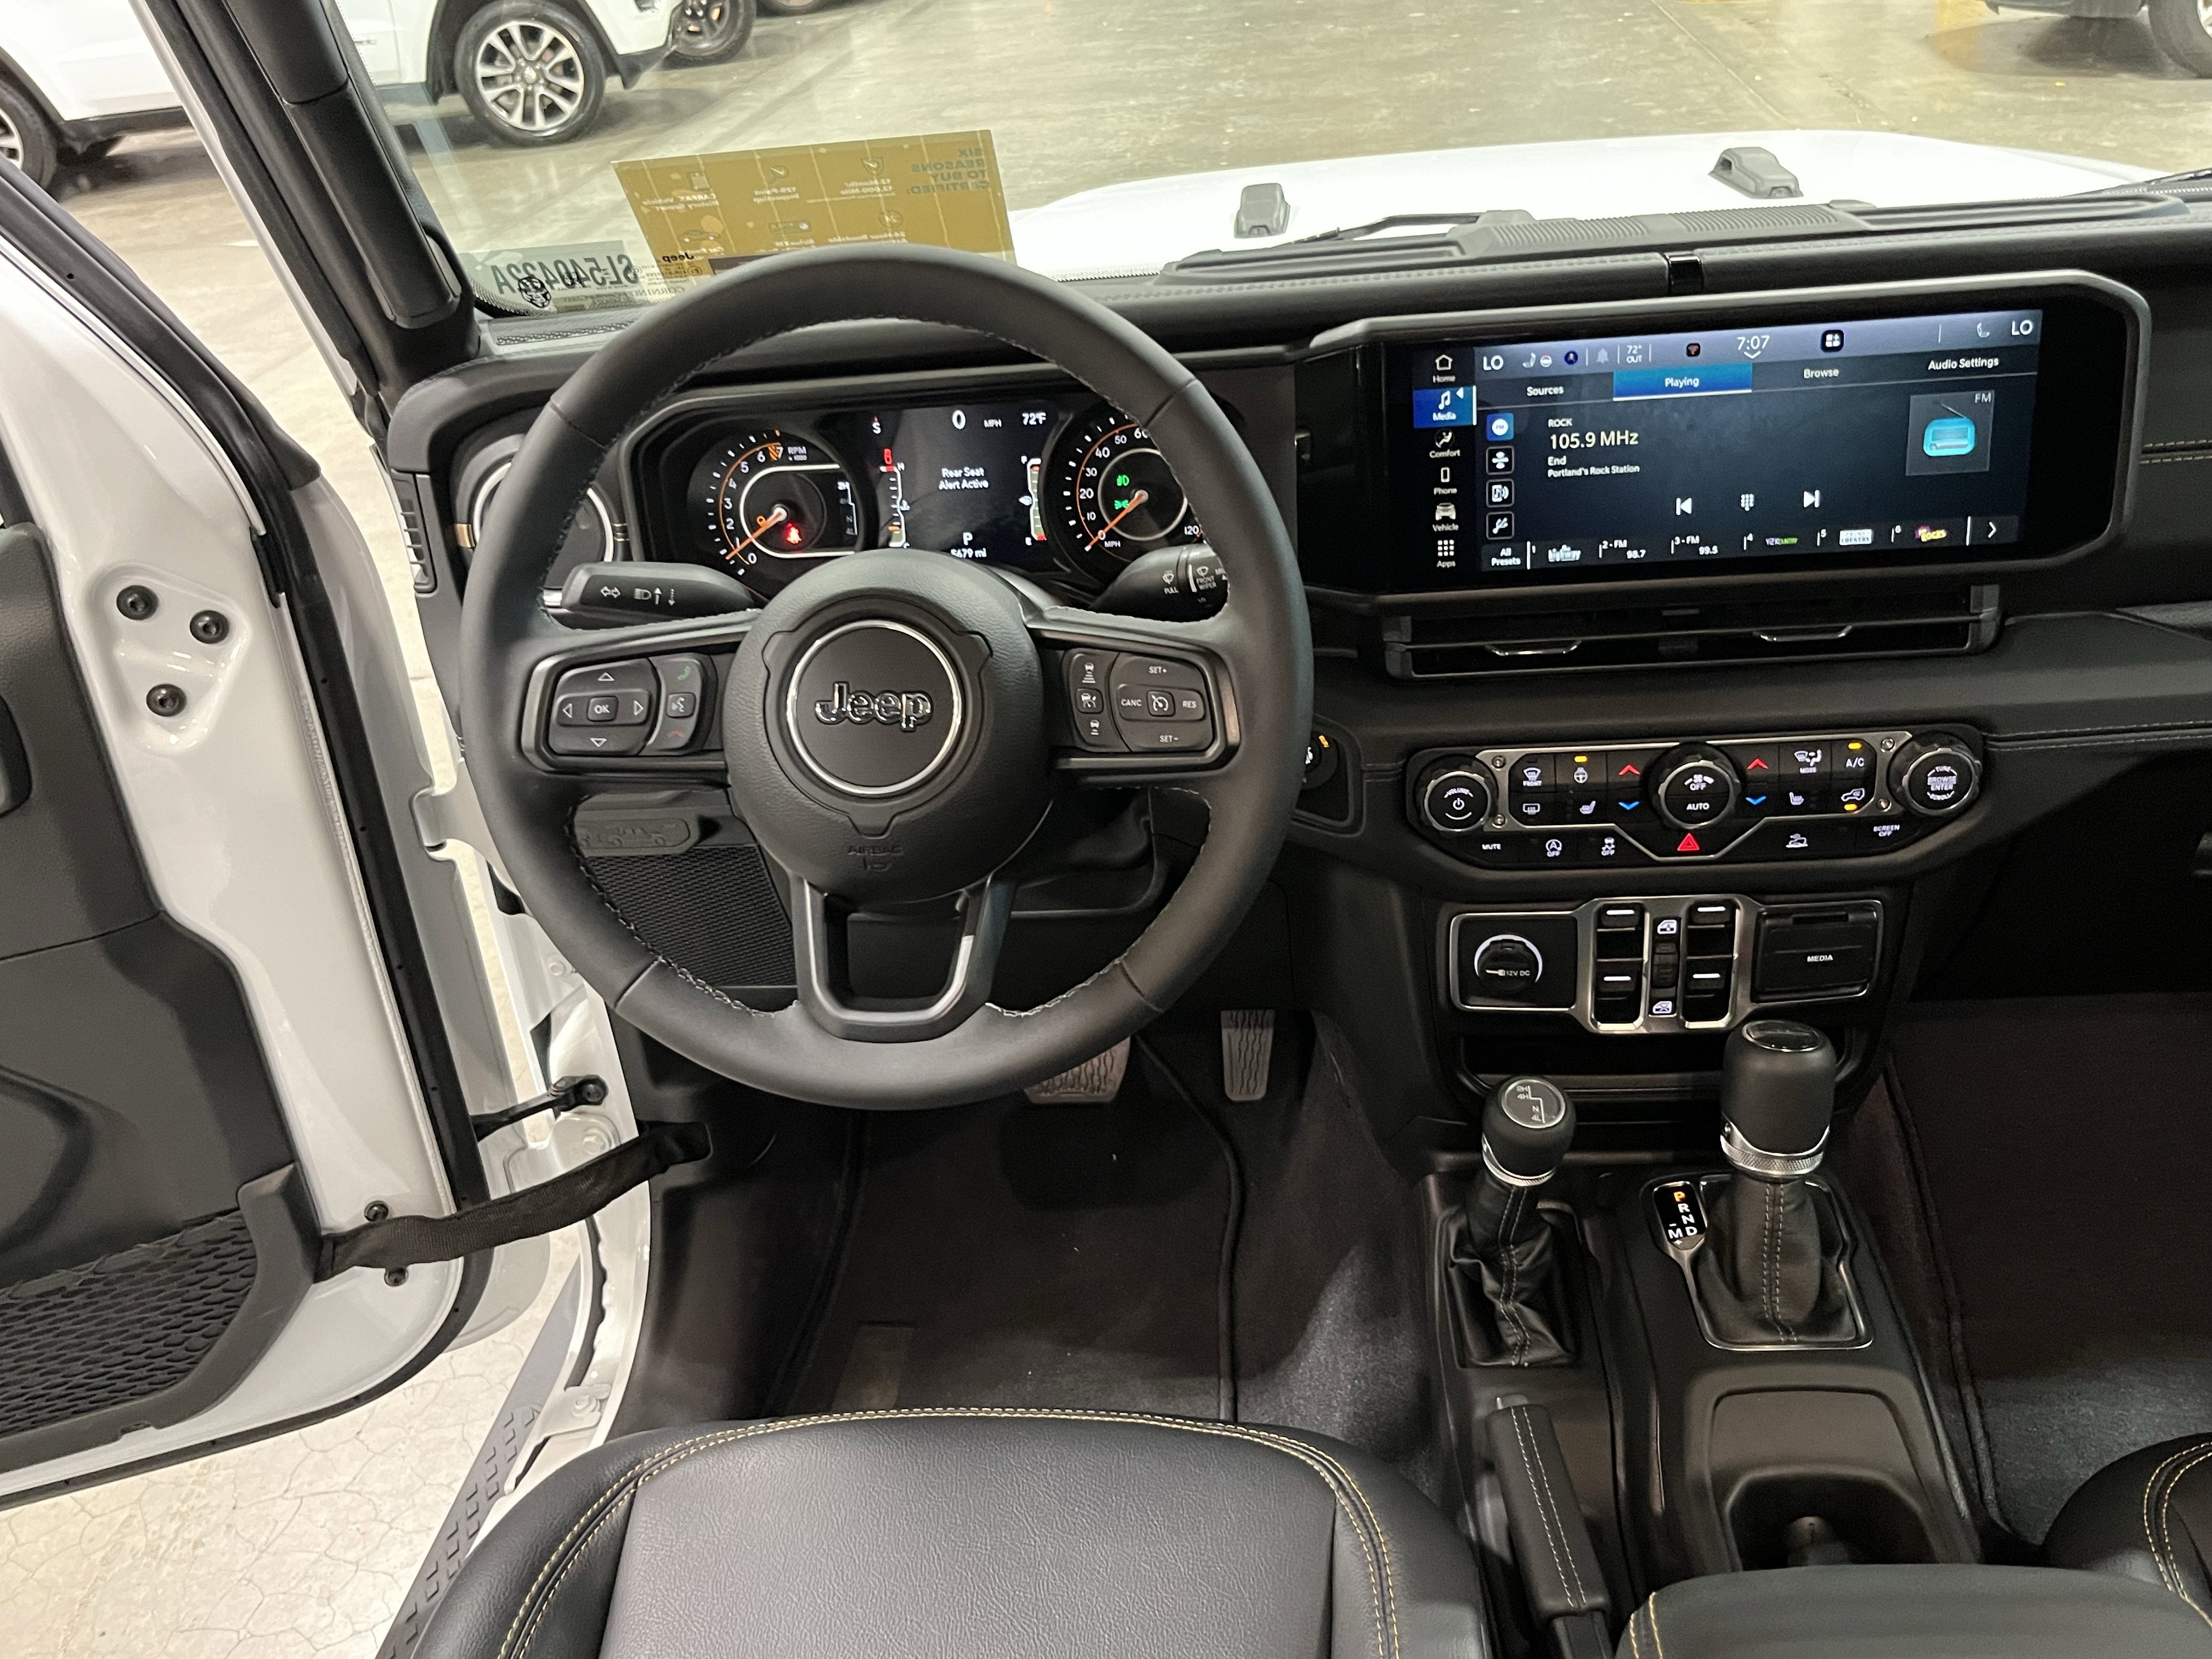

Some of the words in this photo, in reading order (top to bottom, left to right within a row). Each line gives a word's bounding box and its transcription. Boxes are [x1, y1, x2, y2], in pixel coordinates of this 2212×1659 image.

[2011, 319, 2033, 336] LO
[1737, 335, 1770, 350] 7:07
[1482, 354, 1504, 371] LO
[1626, 354, 1643, 364] OUT
[1928, 358, 1957, 371] Audio
[1959, 356, 2000, 370] Settings
[1803, 367, 1839, 379] Browse
[1432, 375, 1456, 383] Home
[1664, 376, 1700, 388] Playing
[1526, 385, 1564, 397] Sources
[1974, 392, 1991, 403] FM
[952, 409, 966, 430] 0
[1432, 411, 1457, 421] Media
[872, 421, 882, 435] S
[1548, 418, 1573, 428] ROCK
[1114, 435, 1127, 445] 50
[1550, 432, 1596, 449] 105.9
[1600, 430, 1639, 447] MHz
[757, 451, 766, 462] 6
[1095, 447, 1111, 459] 40
[1429, 448, 1461, 458] Comfort
[1548, 455, 1567, 466] End
[740, 462, 749, 474] 5
[941, 467, 963, 478] Rear
[963, 466, 985, 477] Seat
[1085, 467, 1098, 477] 30
[1548, 467, 1589, 478] Portland's
[1589, 466, 1610, 476] Rock
[1611, 464, 1640, 475] Station
[727, 478, 737, 489] 4
[939, 479, 961, 490] Alert
[961, 478, 989, 490] Active
[1079, 487, 1094, 499] 20
[1433, 486, 1458, 495] Phone
[724, 498, 733, 510] 3
[1086, 511, 1097, 521] 10
[726, 518, 735, 529] 2
[1432, 522, 1459, 532] Vehicle
[1183, 525, 1200, 535] 120
[1820, 529, 1827, 538] 5
[962, 532, 973, 546] P
[1674, 536, 1680, 545] 3
[1686, 535, 1700, 544] FM
[1747, 533, 1753, 542] 4
[1104, 540, 1121, 548] MPH
[1602, 540, 1609, 549] 2
[1613, 539, 1628, 549] FM
[747, 553, 757, 564] 0
[1436, 559, 1455, 568] Apps
[1491, 556, 1521, 566] Presets
[594, 704, 611, 714] OK
[815, 681, 933, 732] Jeep
[1121, 698, 1143, 707] CANC
[1182, 700, 1197, 709] RES
[1845, 757, 1865, 768] A/C
[1690, 782, 1707, 791] OFF
[1686, 802, 1710, 811] AUTO
[1807, 953, 1833, 963] MEDIA
[1673, 1191, 1686, 1202] P
[1678, 1203, 1690, 1213] R
[1681, 1214, 1695, 1224] N
[1668, 1228, 1683, 1239] M
[1685, 1226, 1697, 1236] D
